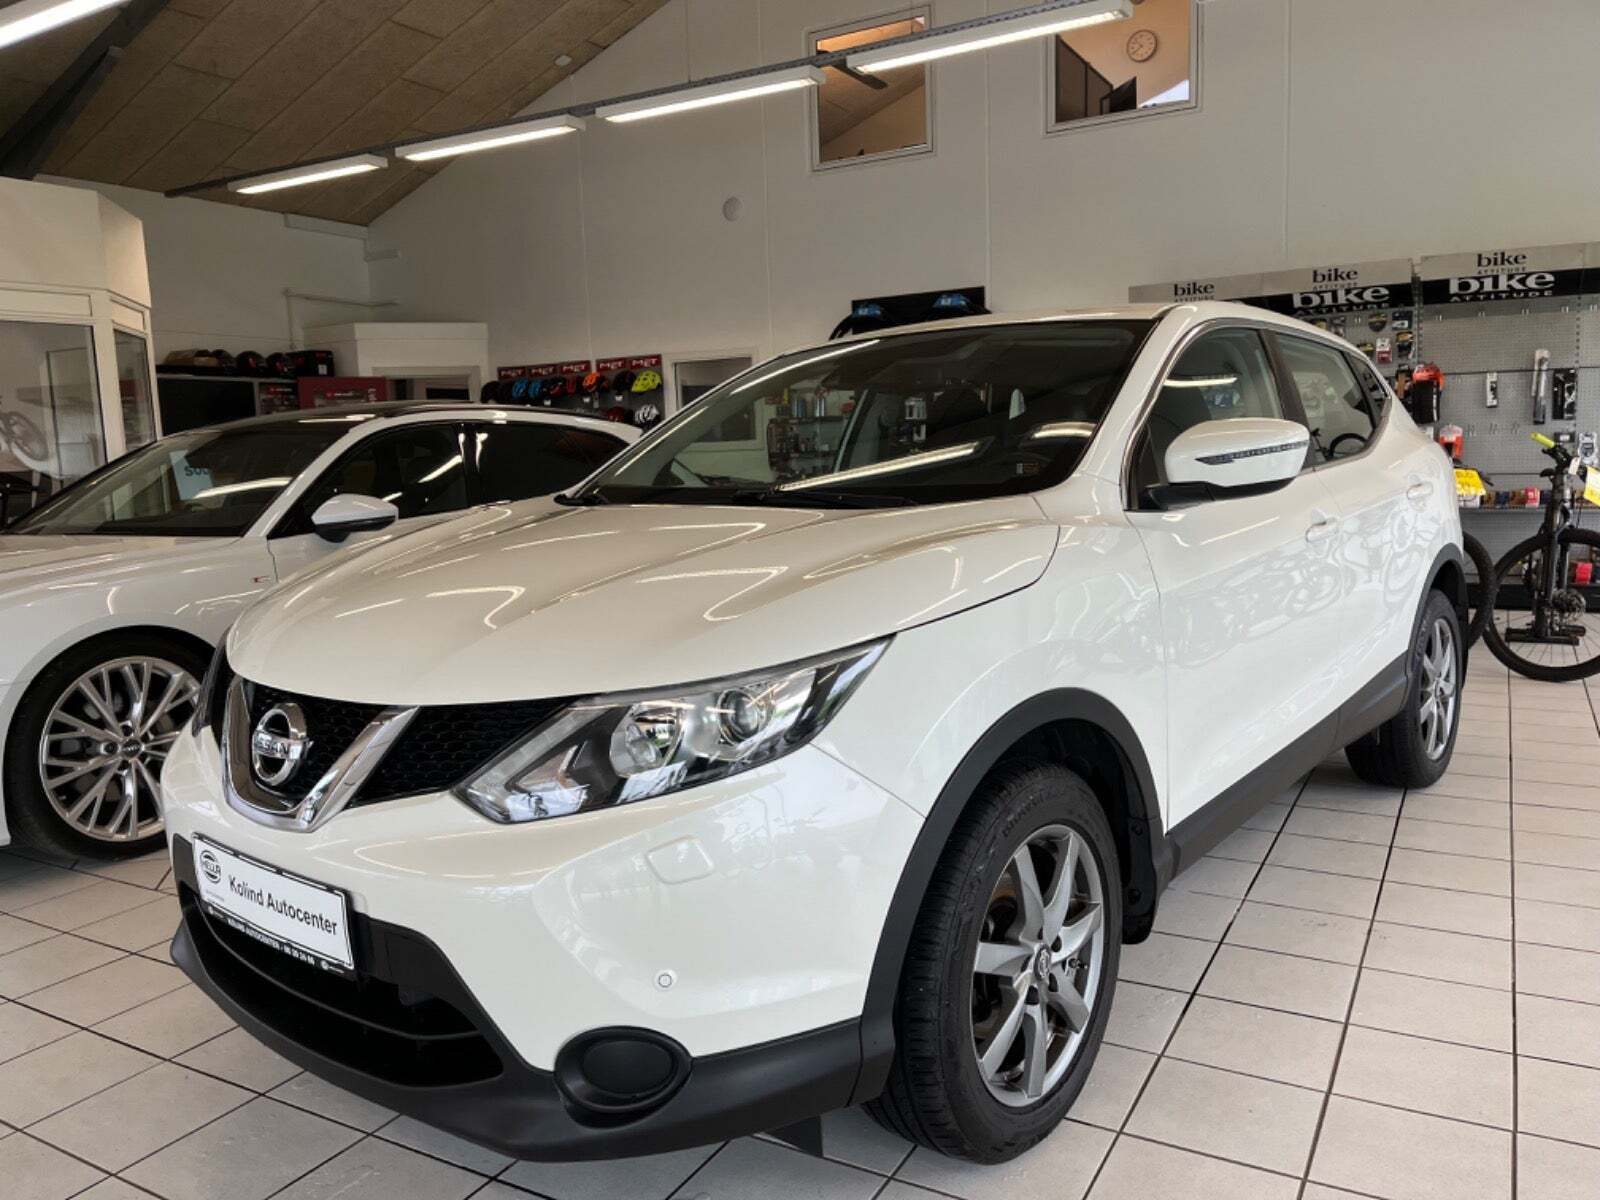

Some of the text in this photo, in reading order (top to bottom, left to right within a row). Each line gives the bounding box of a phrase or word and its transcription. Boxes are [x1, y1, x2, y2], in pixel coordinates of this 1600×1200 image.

[1477, 252, 1527, 267] bike
[1313, 267, 1358, 283] bike
[1449, 272, 1555, 294] bike
[1174, 282, 1215, 296] bike
[1292, 286, 1390, 308] bike
[1450, 290, 1553, 303] ATTITUDE
[229, 875, 263, 906] Kolind
[267, 893, 337, 936] Autocenter
